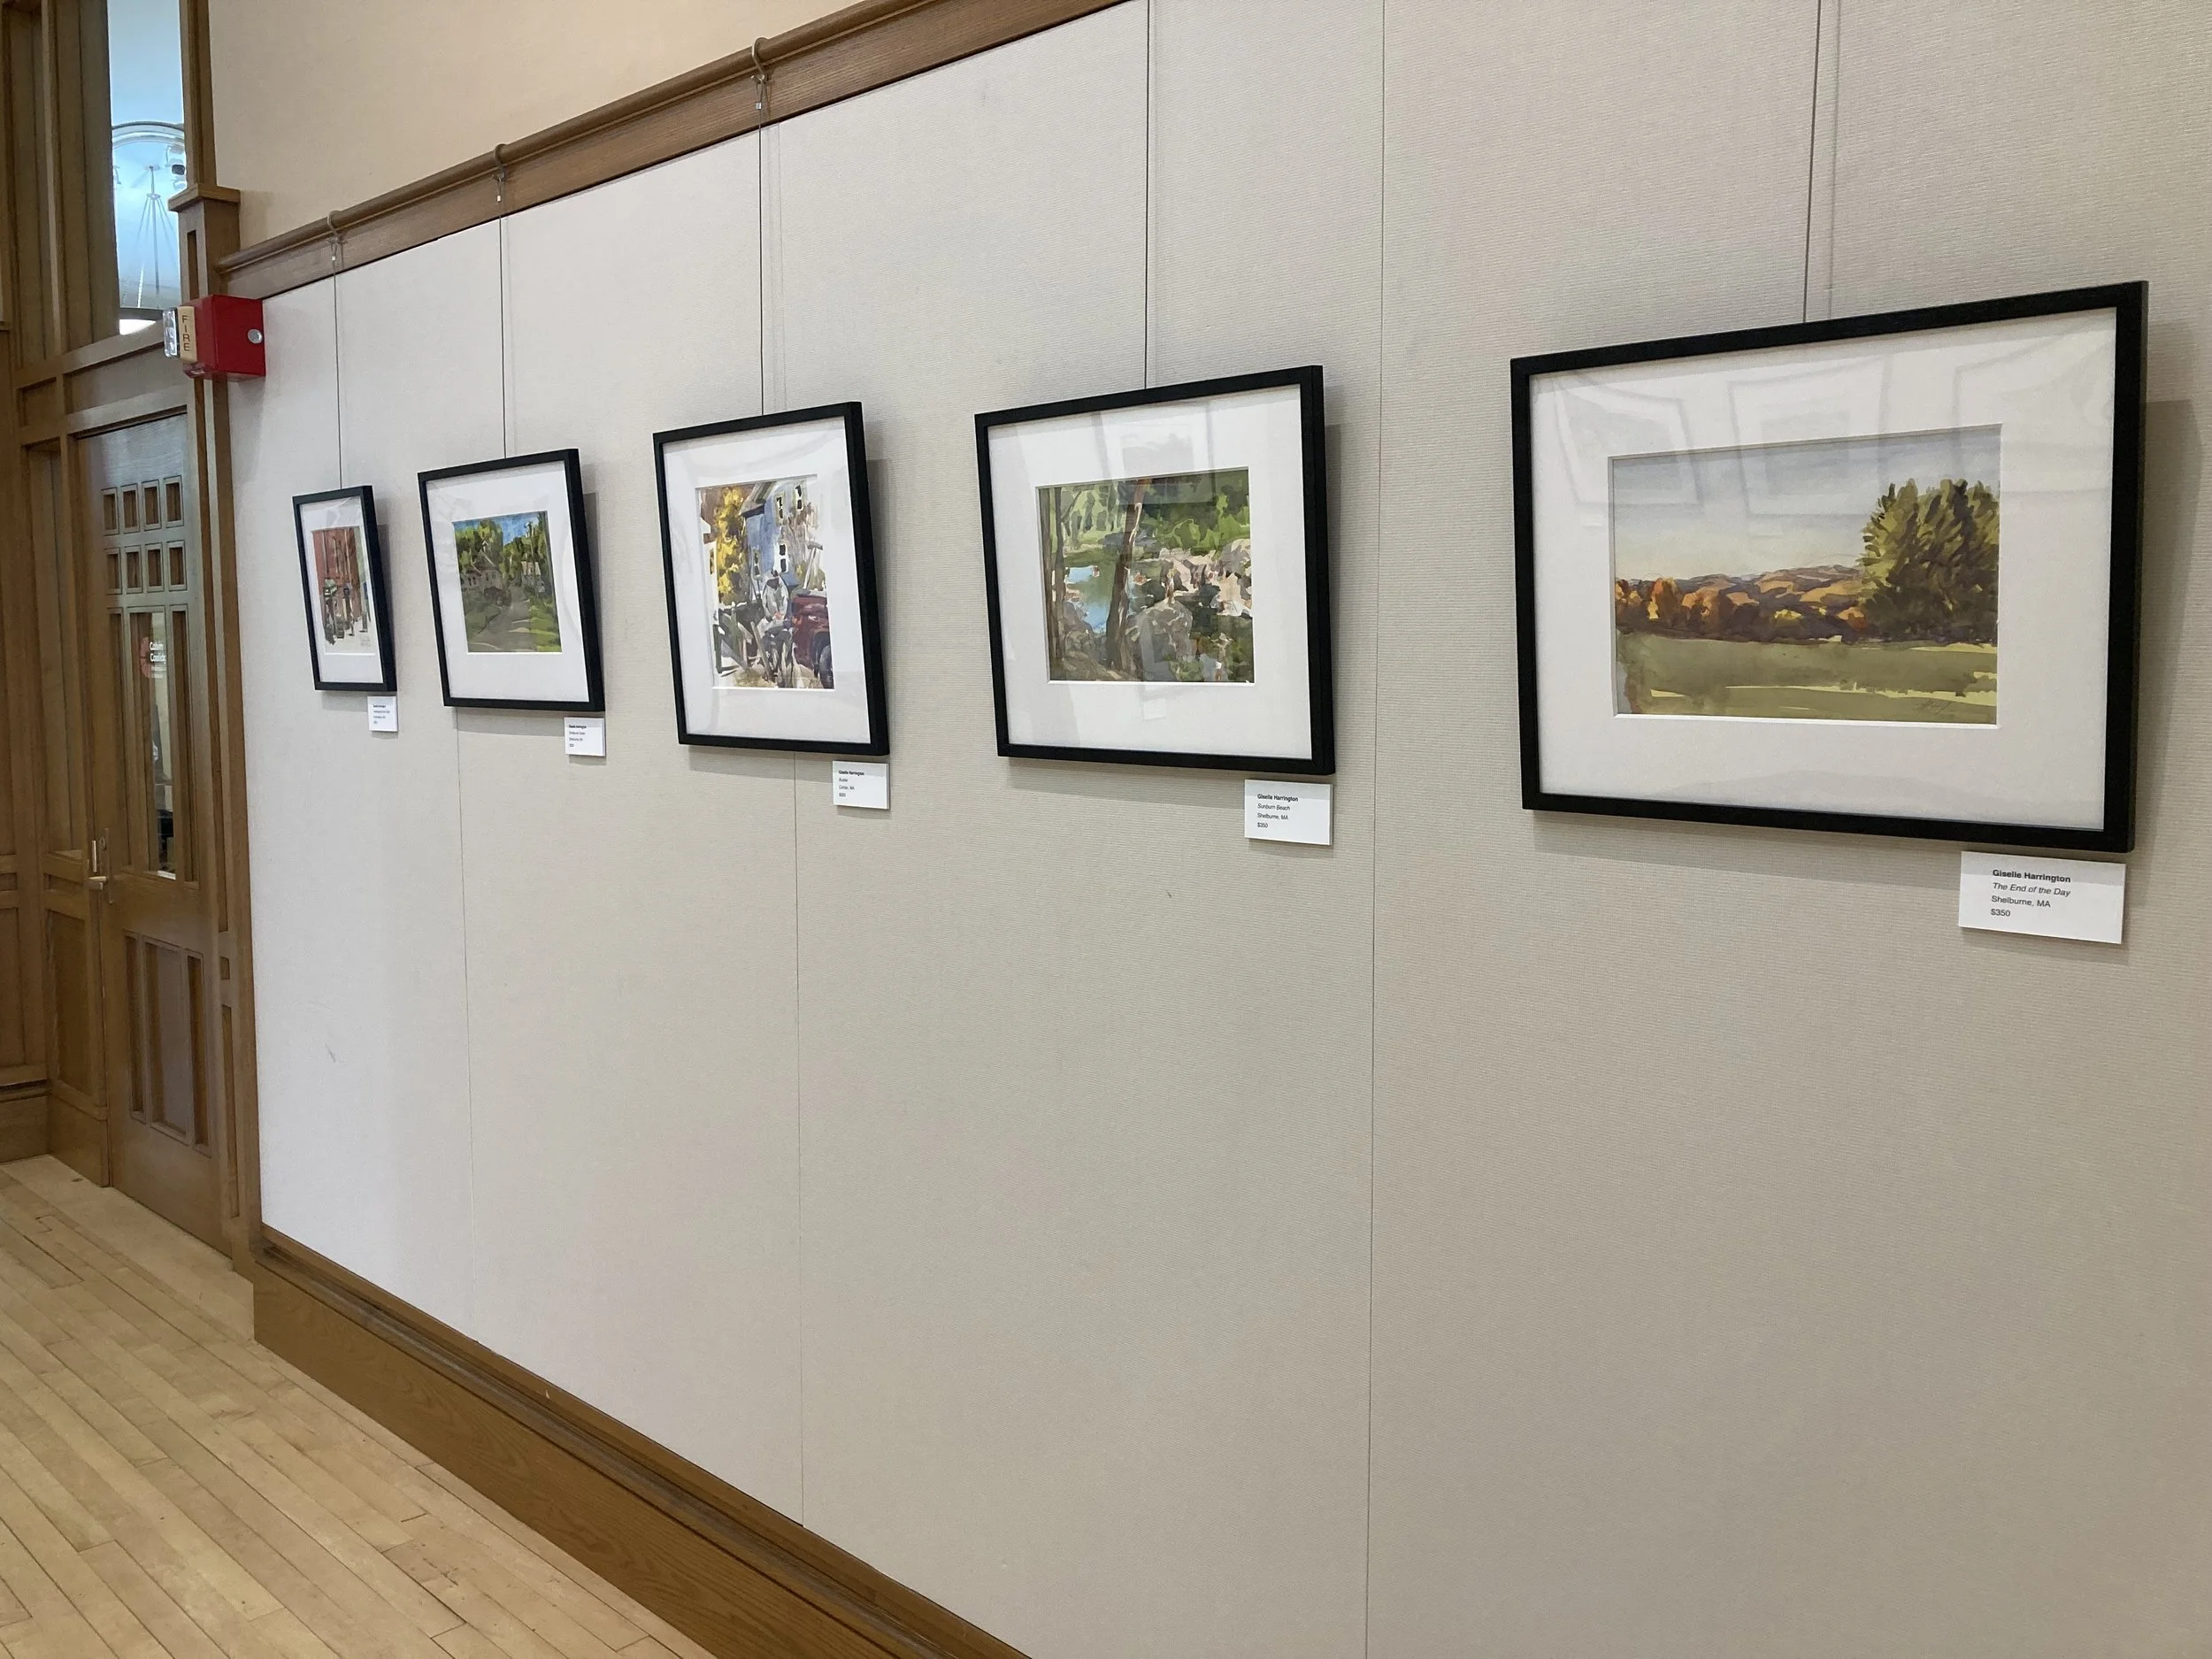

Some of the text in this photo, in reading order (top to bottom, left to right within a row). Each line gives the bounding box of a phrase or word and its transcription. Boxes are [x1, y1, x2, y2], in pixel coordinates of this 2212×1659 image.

[182, 315, 191, 351] FIRE
[1993, 869, 2071, 883] Giselle Harrington
[2010, 884, 2026, 893] End
[2054, 887, 2071, 897] Day
[1991, 895, 2034, 907] Shelburne,
[1991, 908, 2010, 917] $350
